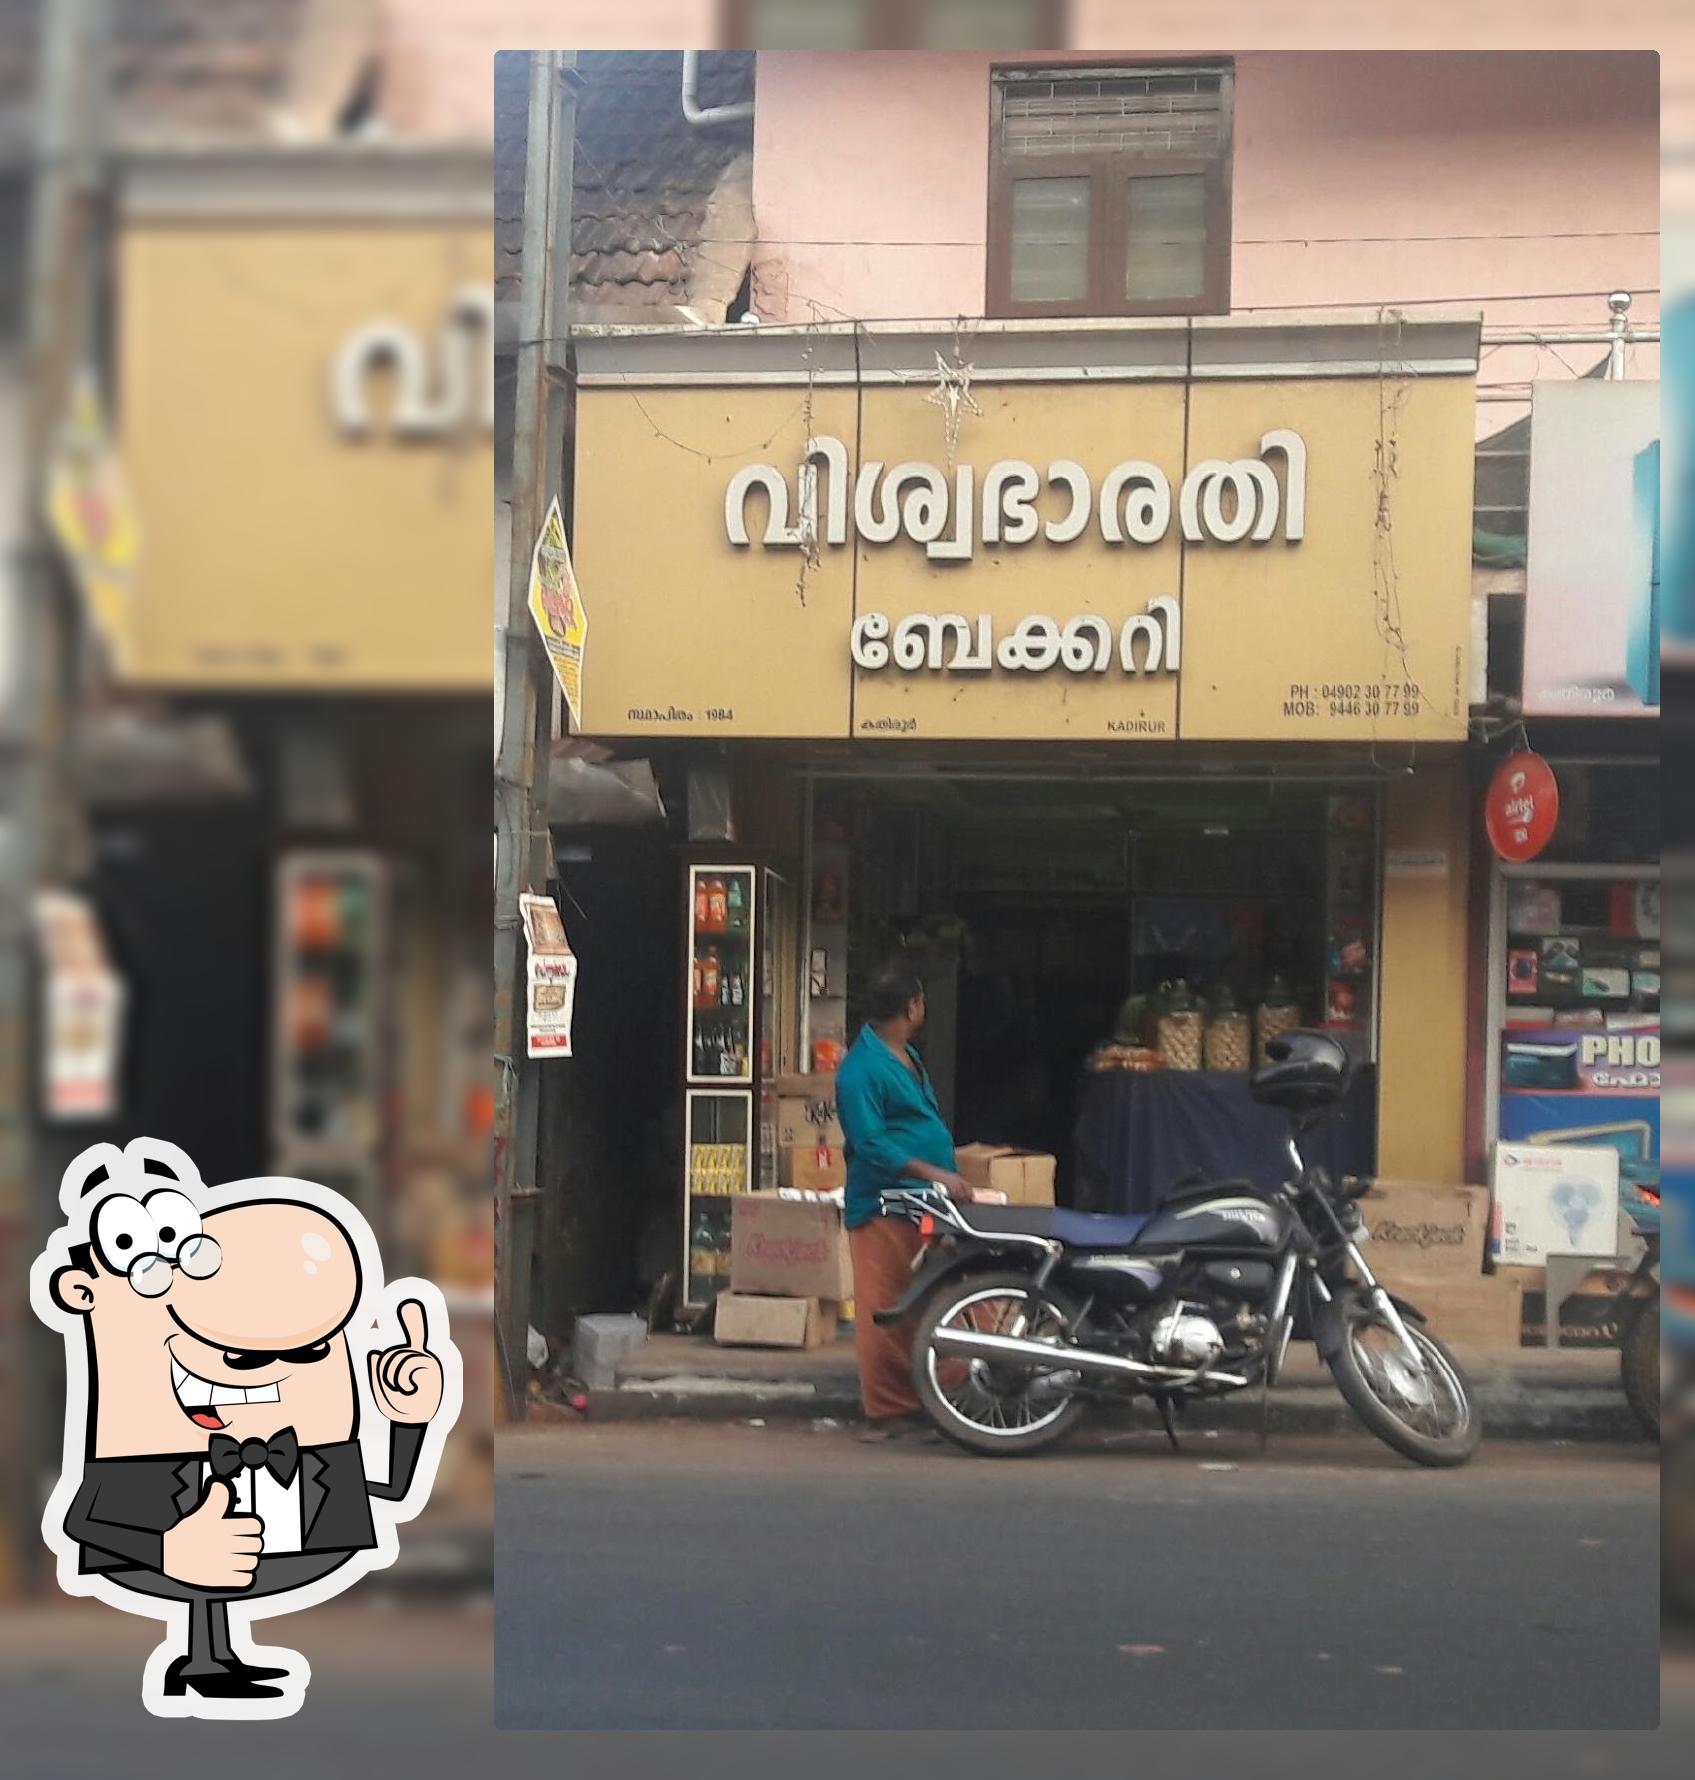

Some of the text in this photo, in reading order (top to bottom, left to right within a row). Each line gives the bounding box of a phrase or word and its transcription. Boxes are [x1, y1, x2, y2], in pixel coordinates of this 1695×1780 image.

[723, 428, 1308, 561] വിശ്വഭാരതി
[850, 594, 1182, 673] ബേക്കറി
[1290, 684, 1309, 699] PH
[1321, 684, 1361, 699] 04902
[1364, 684, 1380, 699] 30
[1384, 684, 1400, 699] 77
[1329, 701, 1362, 717] 9446
[1364, 701, 1380, 717] 30
[1384, 701, 1400, 717] 77
[1403, 701, 1420, 717] 99
[1106, 719, 1167, 734] KADIRUR
[1581, 1034, 1661, 1069] PHO
